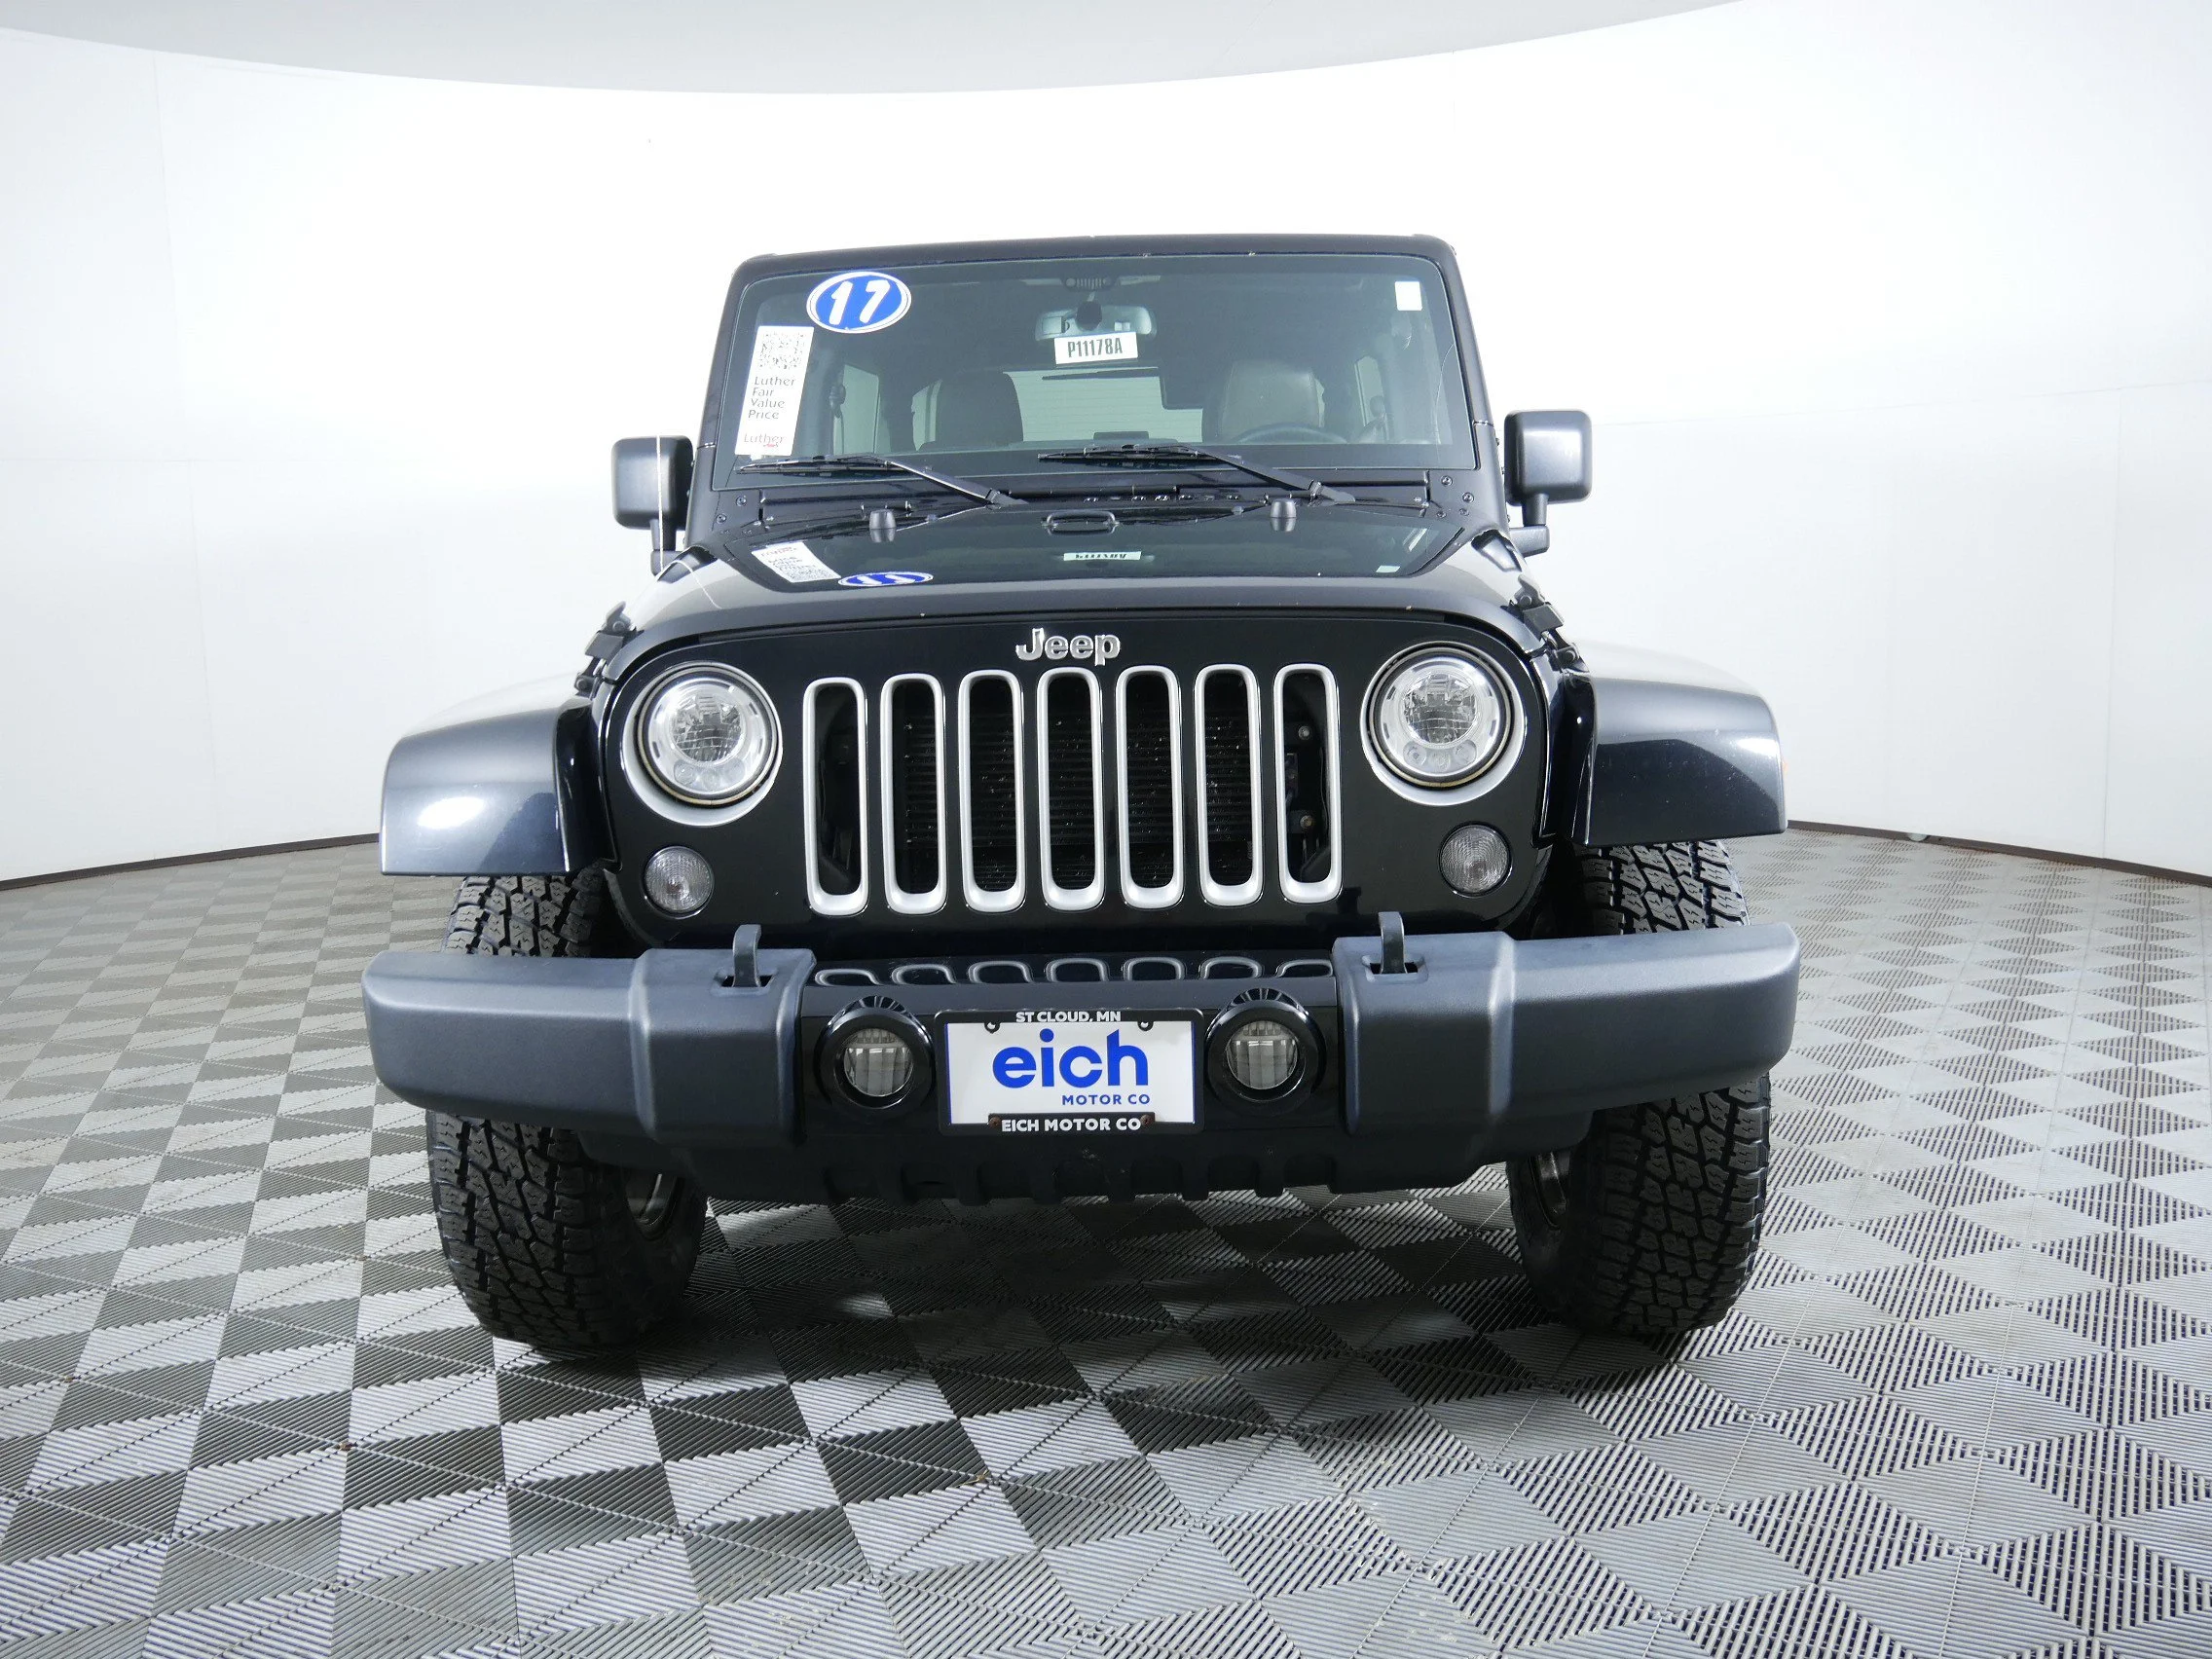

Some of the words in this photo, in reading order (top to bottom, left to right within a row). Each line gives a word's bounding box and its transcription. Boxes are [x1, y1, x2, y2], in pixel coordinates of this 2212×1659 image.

[829, 279, 891, 325] 17
[1067, 337, 1123, 358] P11178A
[755, 376, 795, 386] Luther
[753, 387, 774, 396] Fair
[751, 398, 785, 408] Value
[749, 409, 779, 419] Price
[744, 433, 785, 444] Luther
[1015, 627, 1121, 666] Jeep
[1016, 1011, 1034, 1023] ST
[1037, 1011, 1093, 1022] CLOUD,
[1096, 1011, 1121, 1022] MN
[992, 1028, 1149, 1088] eich
[1062, 1094, 1122, 1105] MOTOR
[1127, 1093, 1150, 1105] CO
[1002, 1119, 1039, 1131] EICH
[1044, 1118, 1111, 1131] MOTOR
[1114, 1118, 1141, 1130] CO
